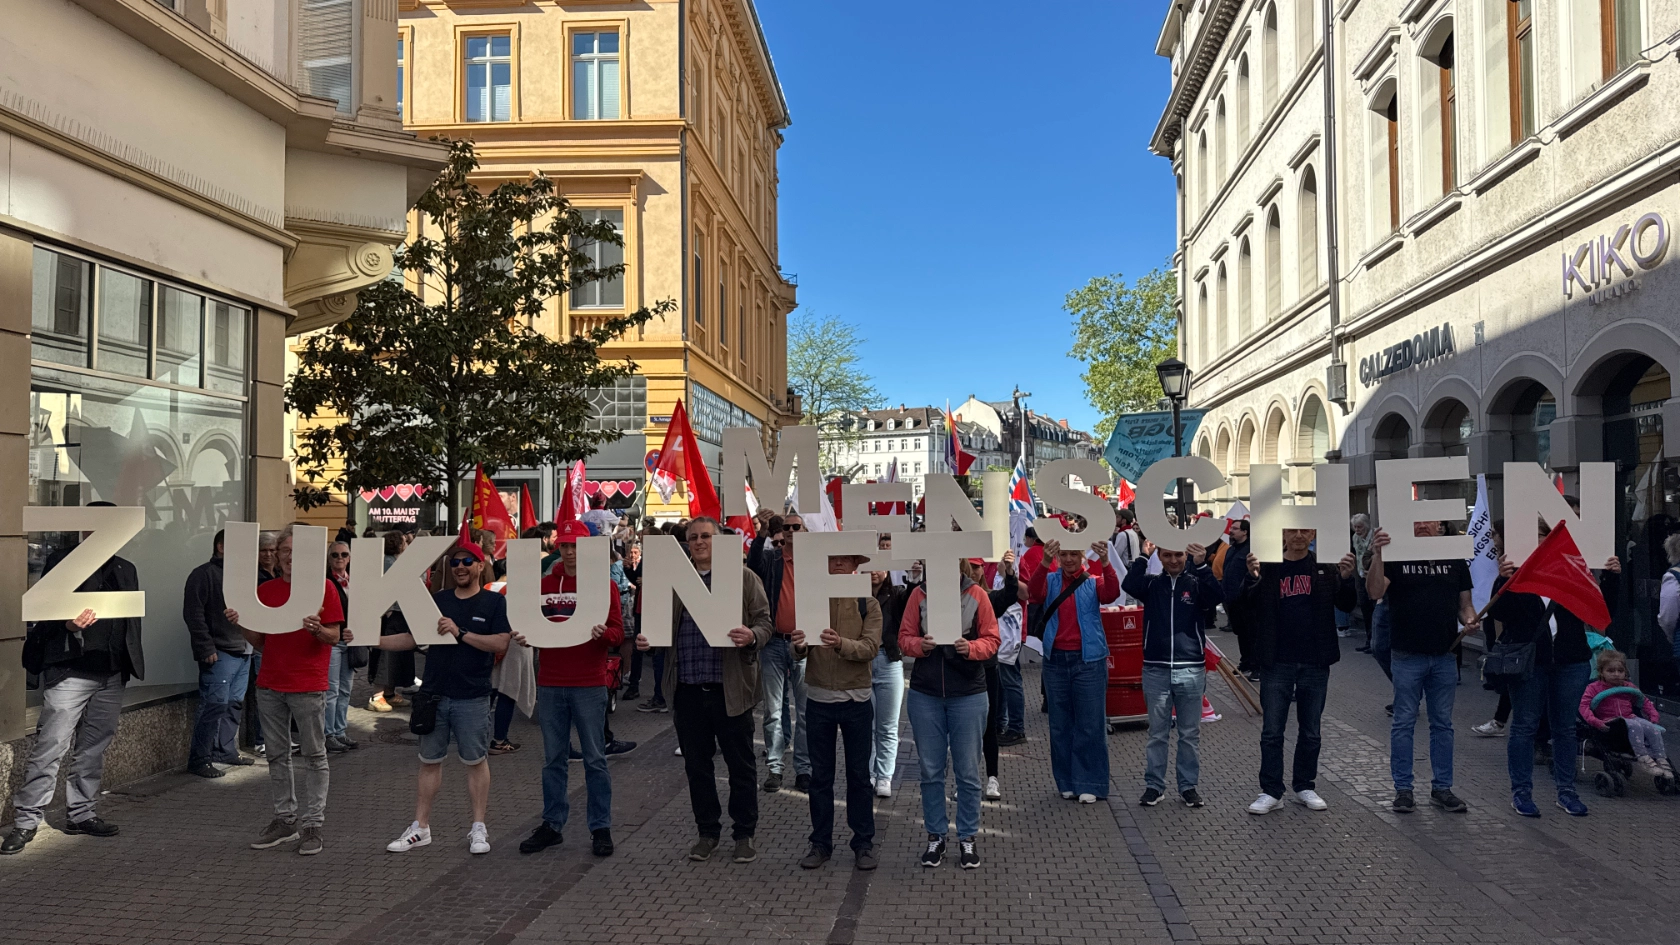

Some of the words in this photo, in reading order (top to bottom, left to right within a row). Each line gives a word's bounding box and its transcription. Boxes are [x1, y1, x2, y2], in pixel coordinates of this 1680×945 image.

[1562, 212, 1667, 298] KIKO
[1359, 321, 1454, 386] CALZEDONIA
[722, 426, 1616, 570] MENSCHEN
[22, 506, 994, 648] ZUKUNFT
